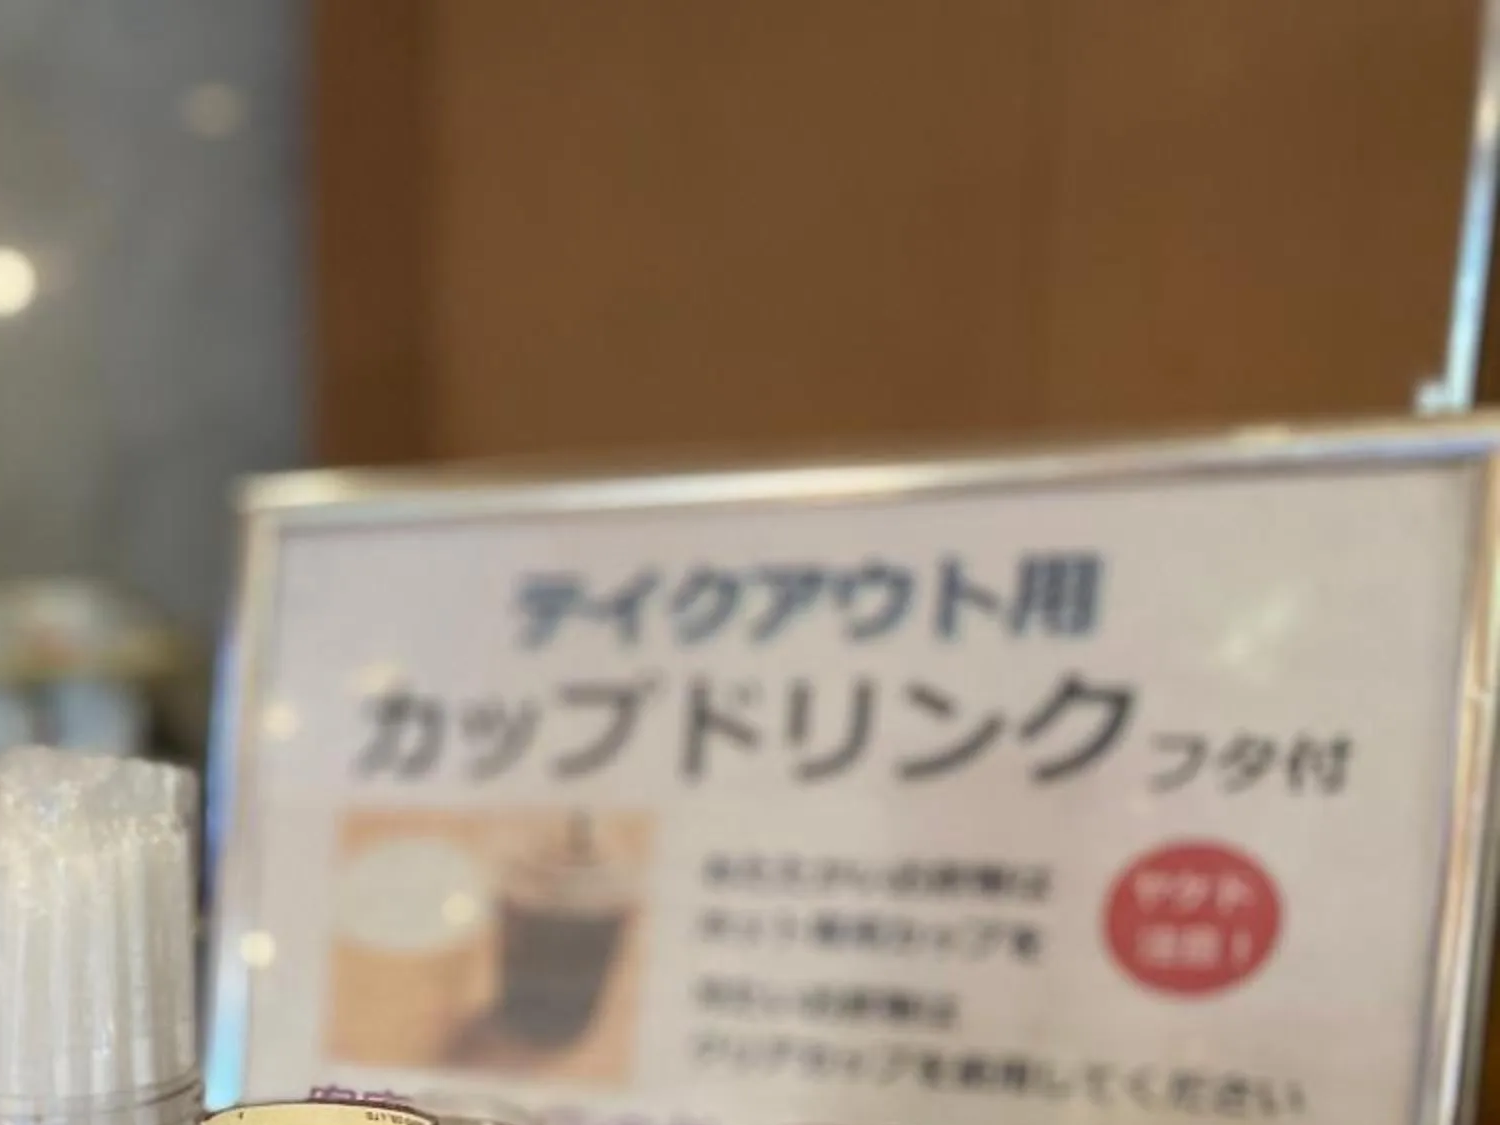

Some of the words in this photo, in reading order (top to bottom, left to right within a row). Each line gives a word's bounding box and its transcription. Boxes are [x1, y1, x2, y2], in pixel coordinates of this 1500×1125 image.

[512, 555, 1104, 652] テイクアウト用
[359, 669, 1137, 784] カップドリンク
